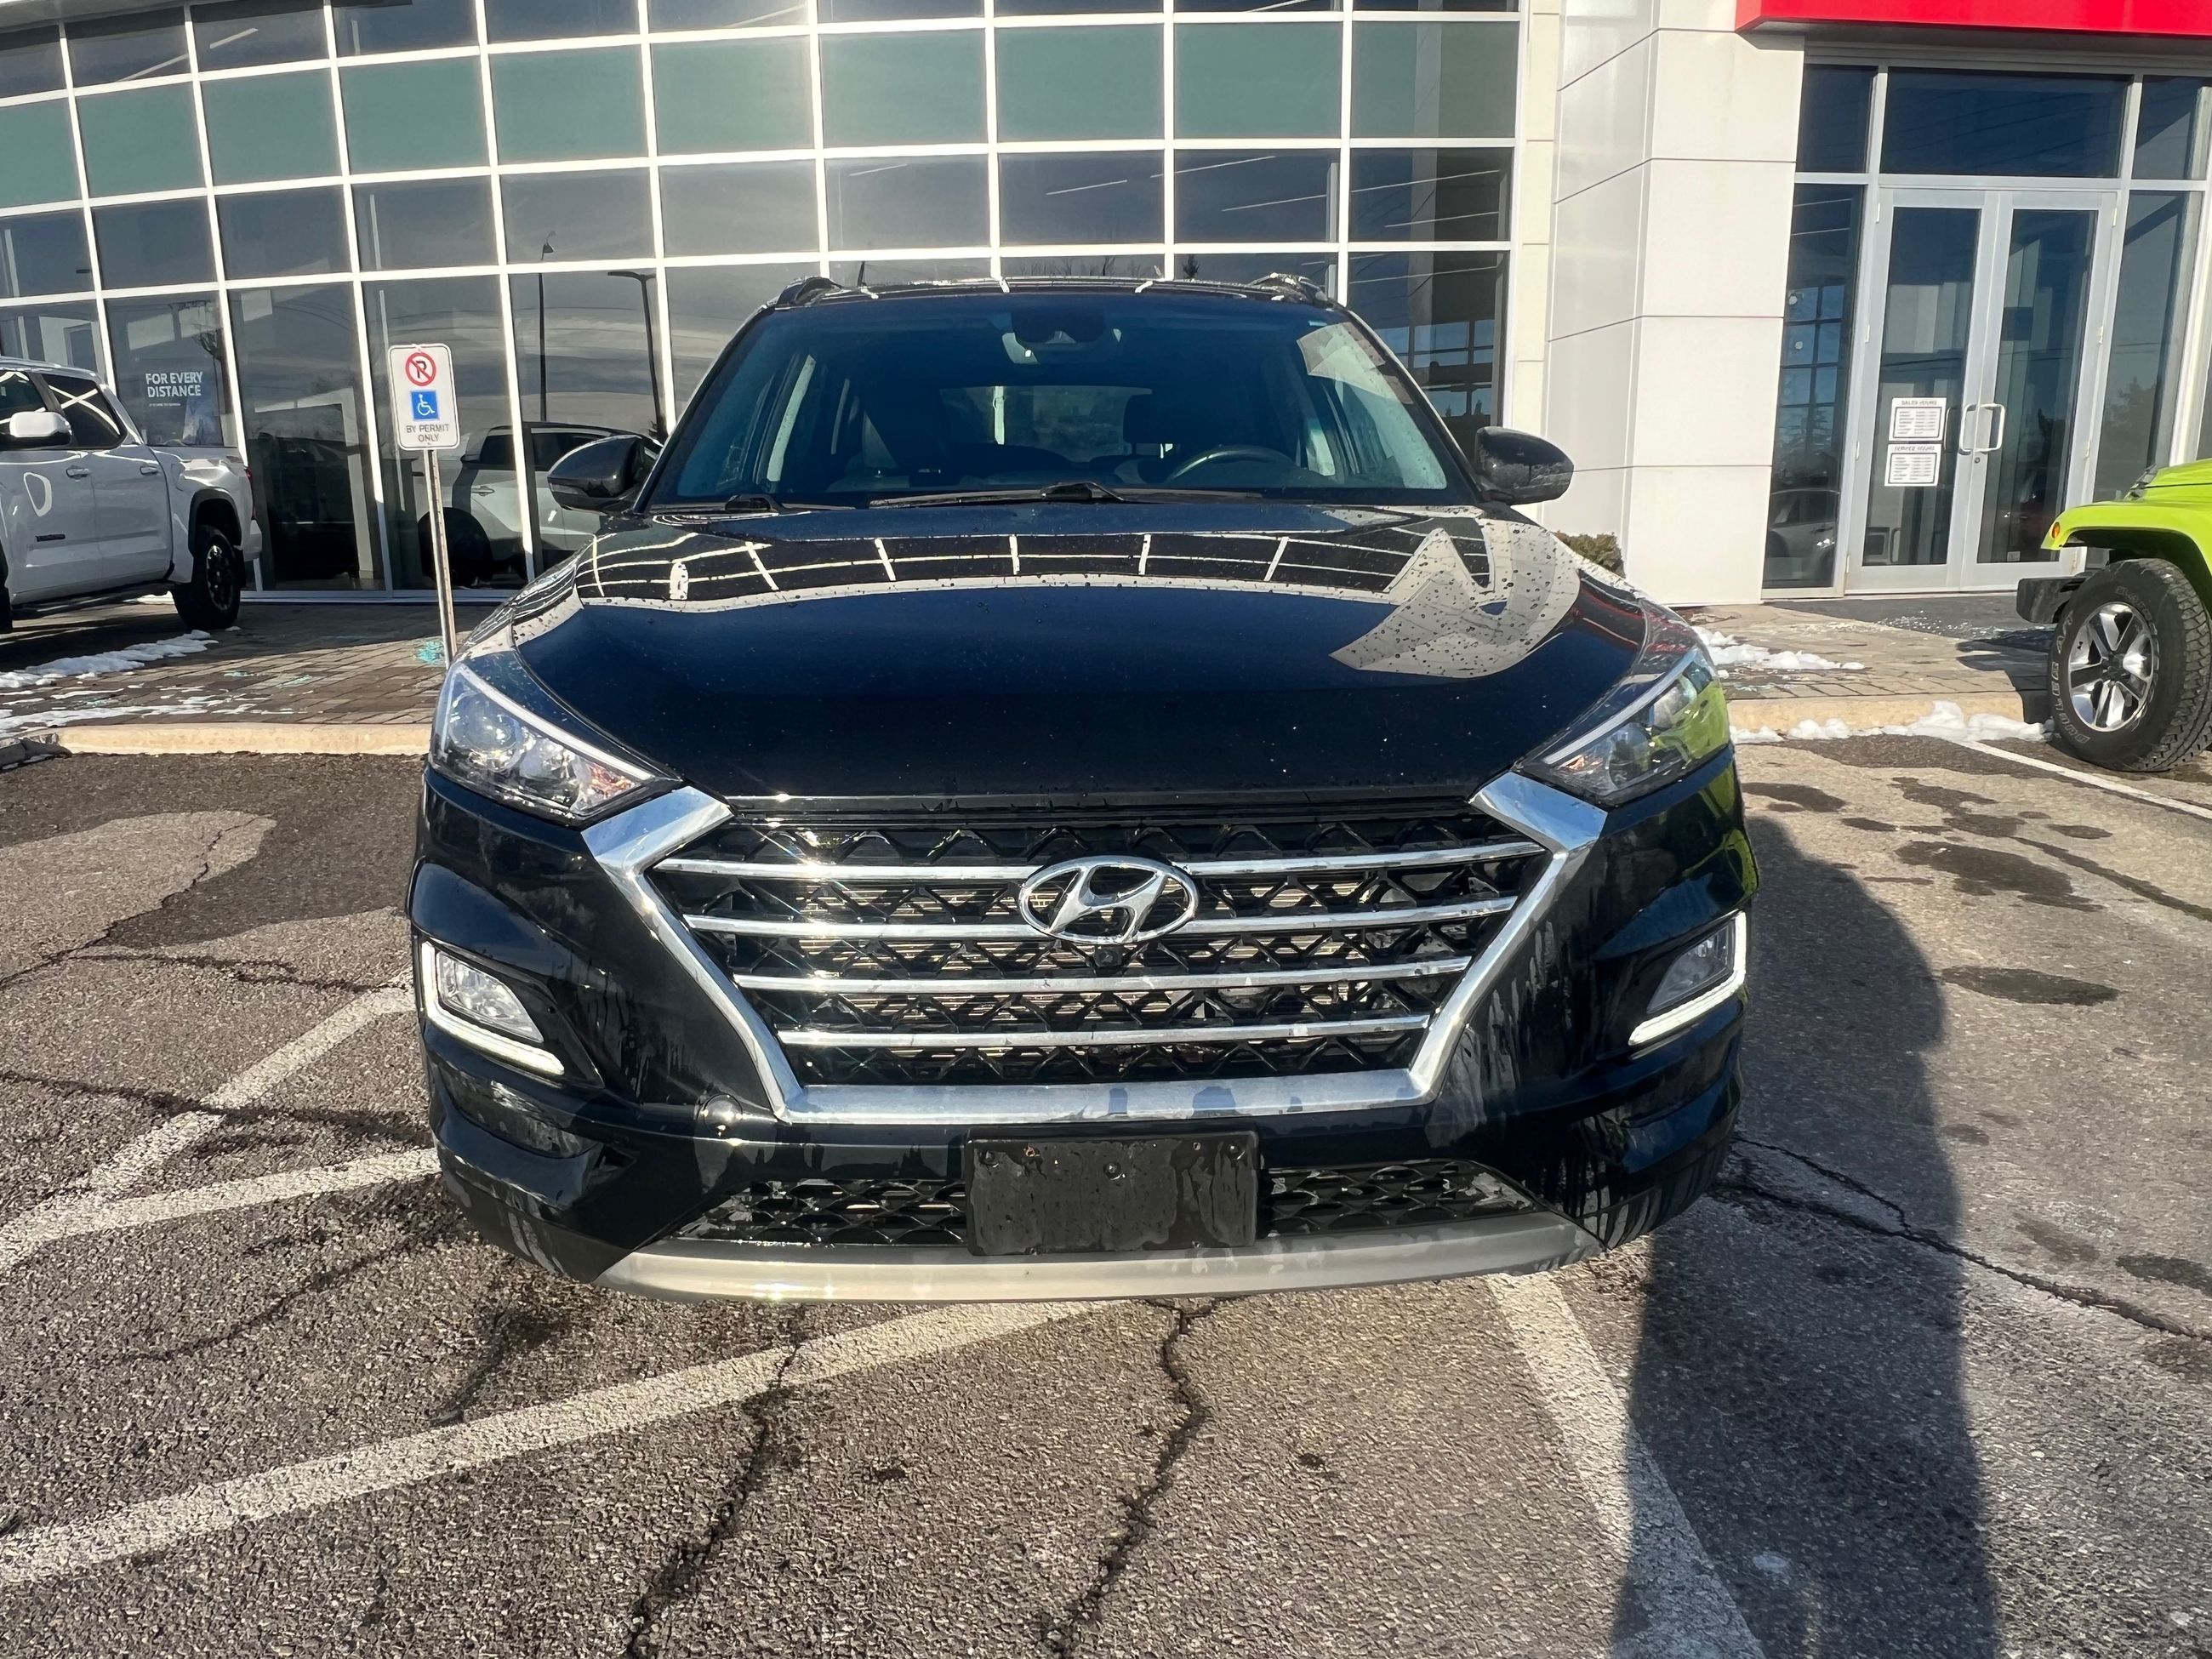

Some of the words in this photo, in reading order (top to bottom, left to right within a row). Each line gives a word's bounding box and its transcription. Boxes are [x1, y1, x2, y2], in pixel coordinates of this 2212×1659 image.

[145, 373, 168, 385] FOR
[170, 371, 202, 384] EVERY
[147, 385, 202, 397] DISTANCE
[419, 424, 449, 433] PERMIT
[418, 433, 439, 442] ONLY
